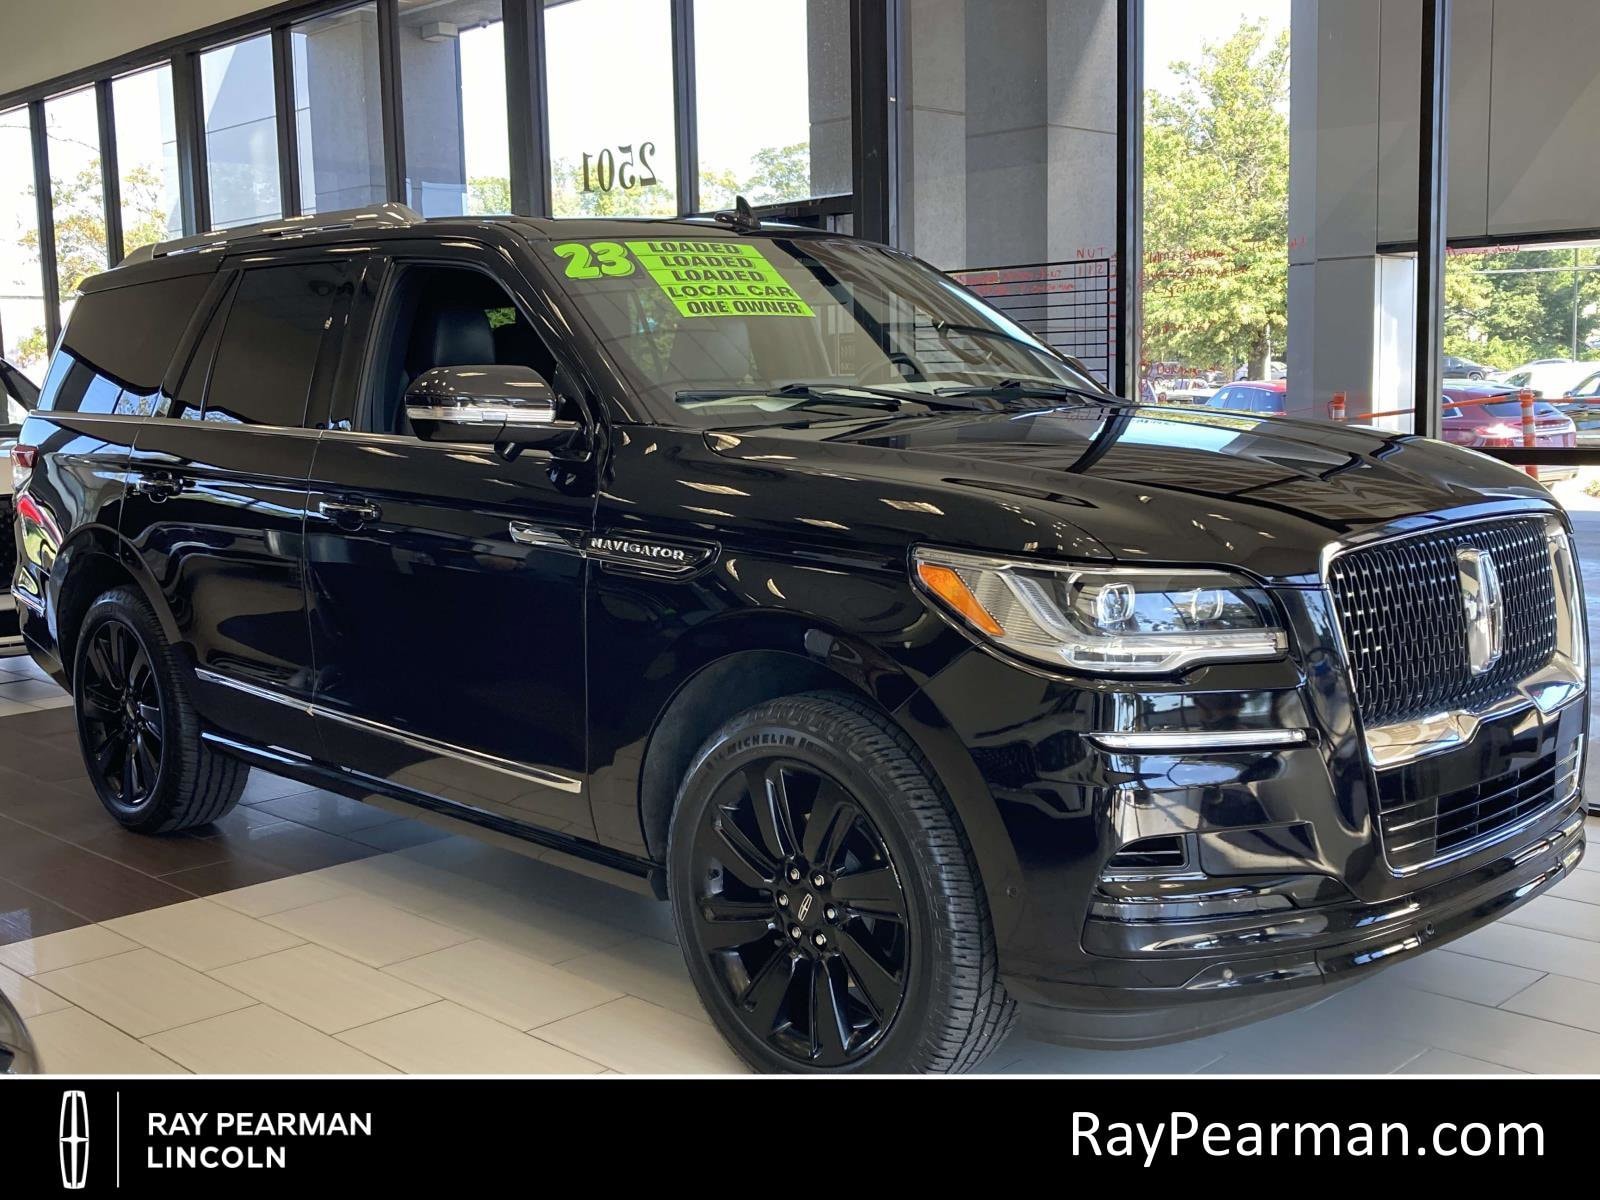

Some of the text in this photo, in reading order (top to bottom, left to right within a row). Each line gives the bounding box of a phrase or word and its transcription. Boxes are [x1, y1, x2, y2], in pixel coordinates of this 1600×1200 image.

[649, 242, 741, 255] LOADED
[553, 242, 635, 280] 23
[660, 255, 756, 269] LOADED
[673, 269, 767, 283] LOADED
[669, 285, 794, 298] LOCAL CAR
[687, 301, 802, 315] ONE OWNER
[590, 537, 685, 561] NAVIGATOR
[728, 733, 796, 753] MICHELIN
